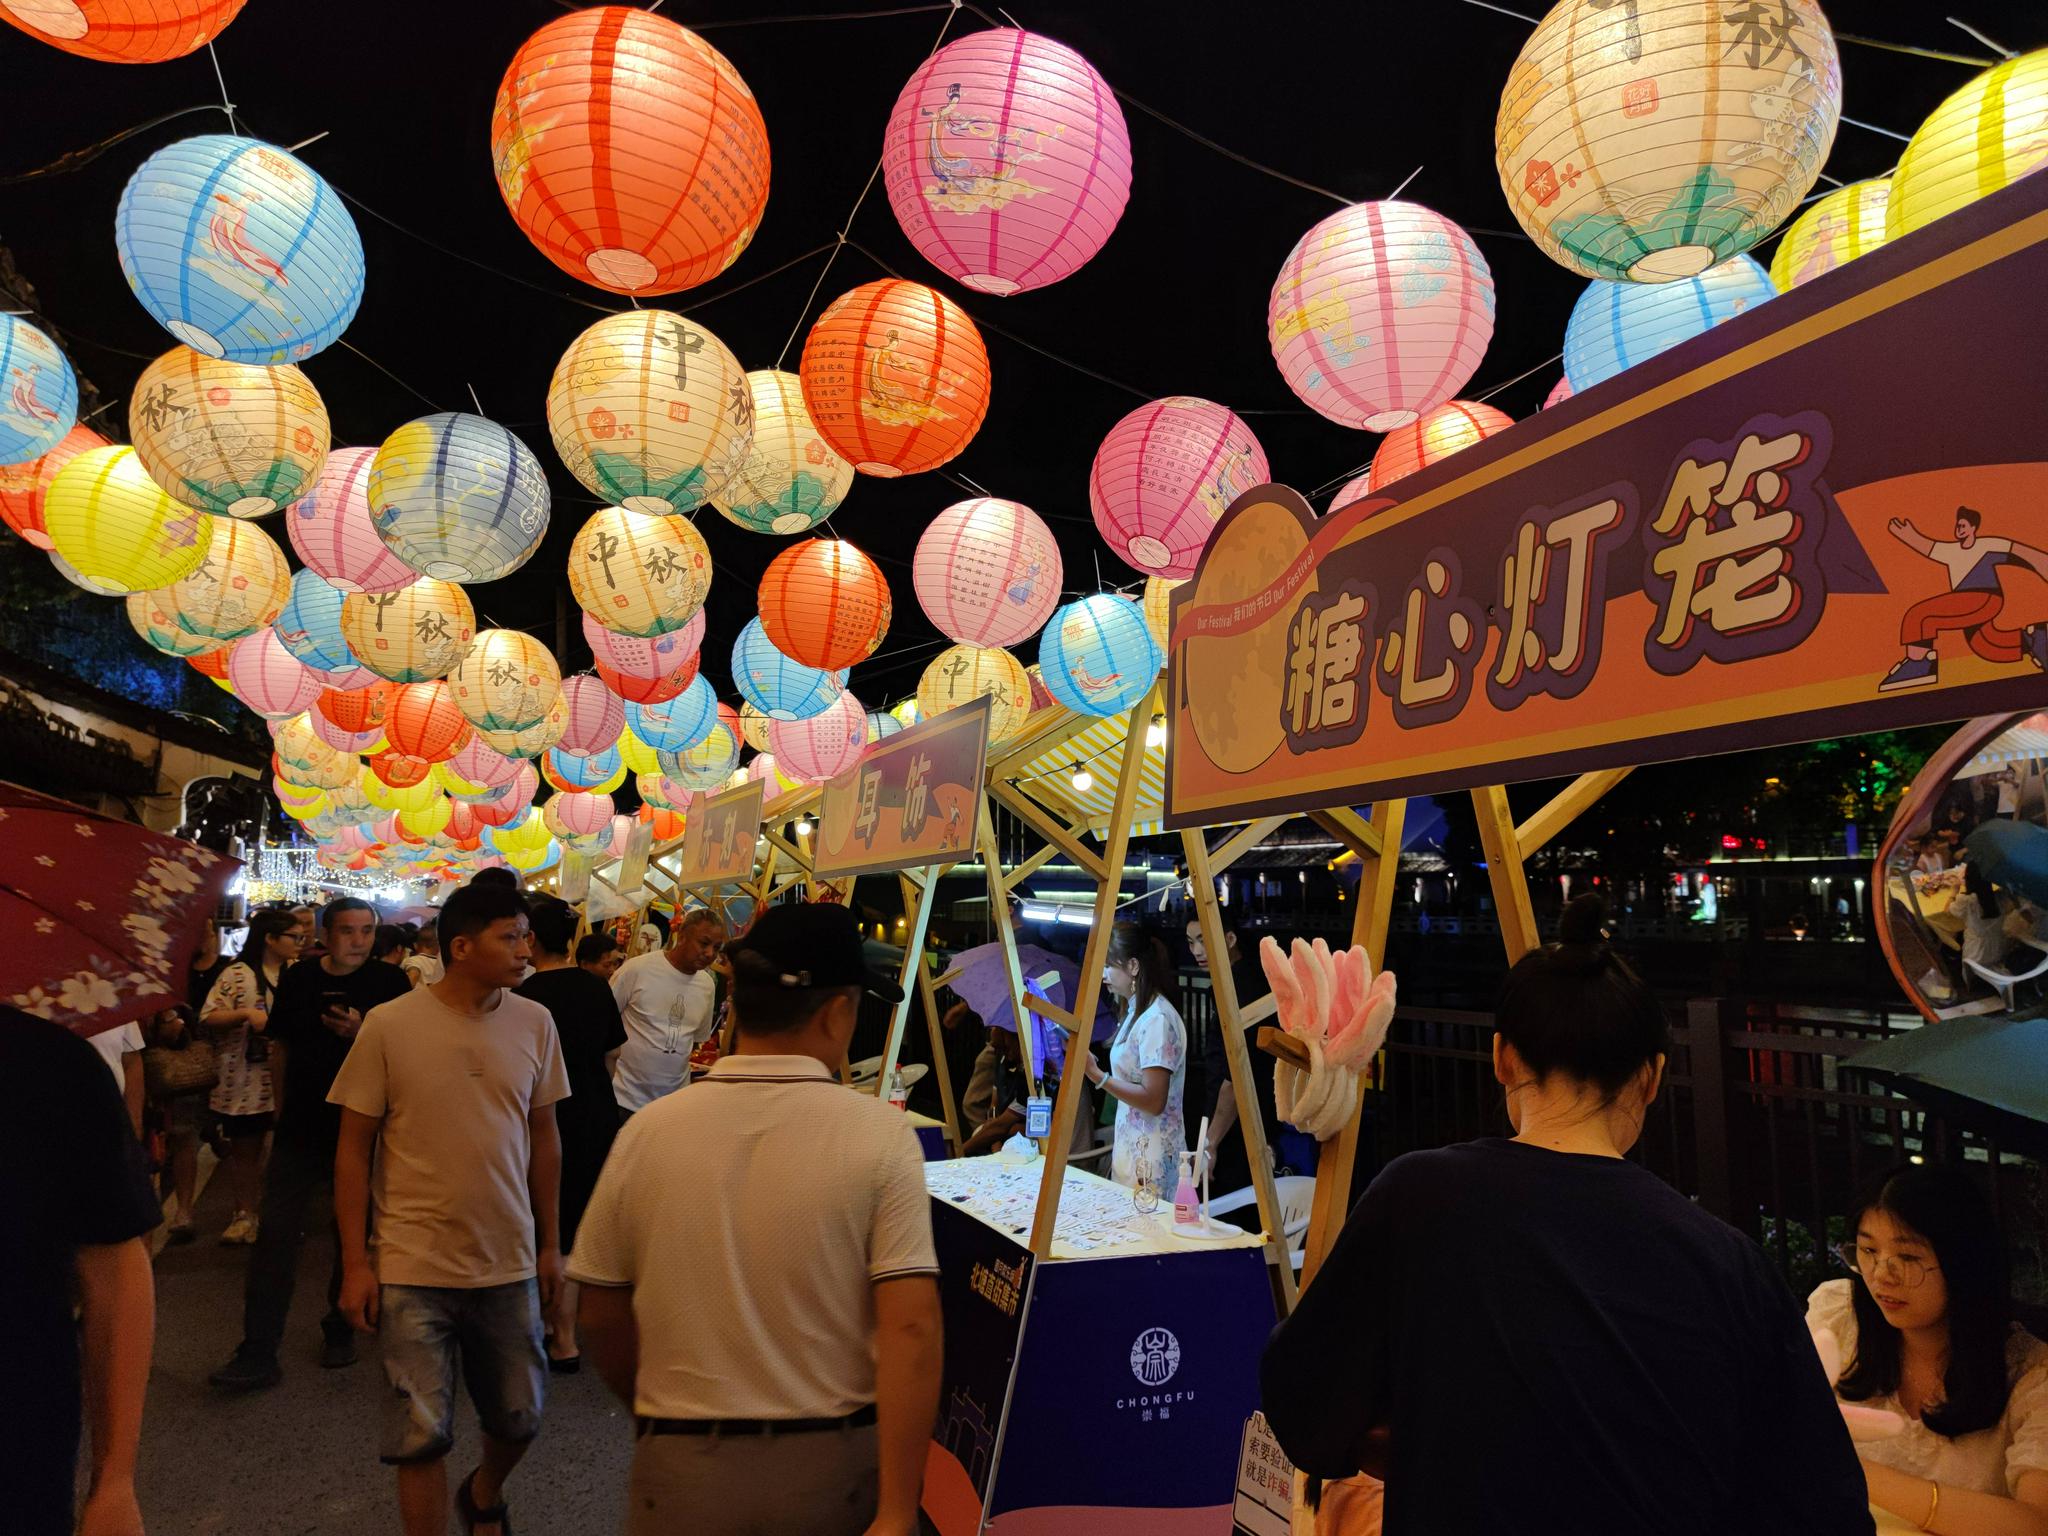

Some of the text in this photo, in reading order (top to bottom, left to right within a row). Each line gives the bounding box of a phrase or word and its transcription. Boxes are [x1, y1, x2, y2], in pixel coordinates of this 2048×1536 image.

[140, 383, 195, 432] 秋
[1197, 549, 1316, 631] Our Festival 我们的节日 Our Festival
[1286, 432, 1812, 737] 糖心灯笼
[1116, 1391, 1195, 1409] CHONGFU
[1142, 1407, 1170, 1422] 崇福
[1248, 1437, 1296, 1481] 索要验证
